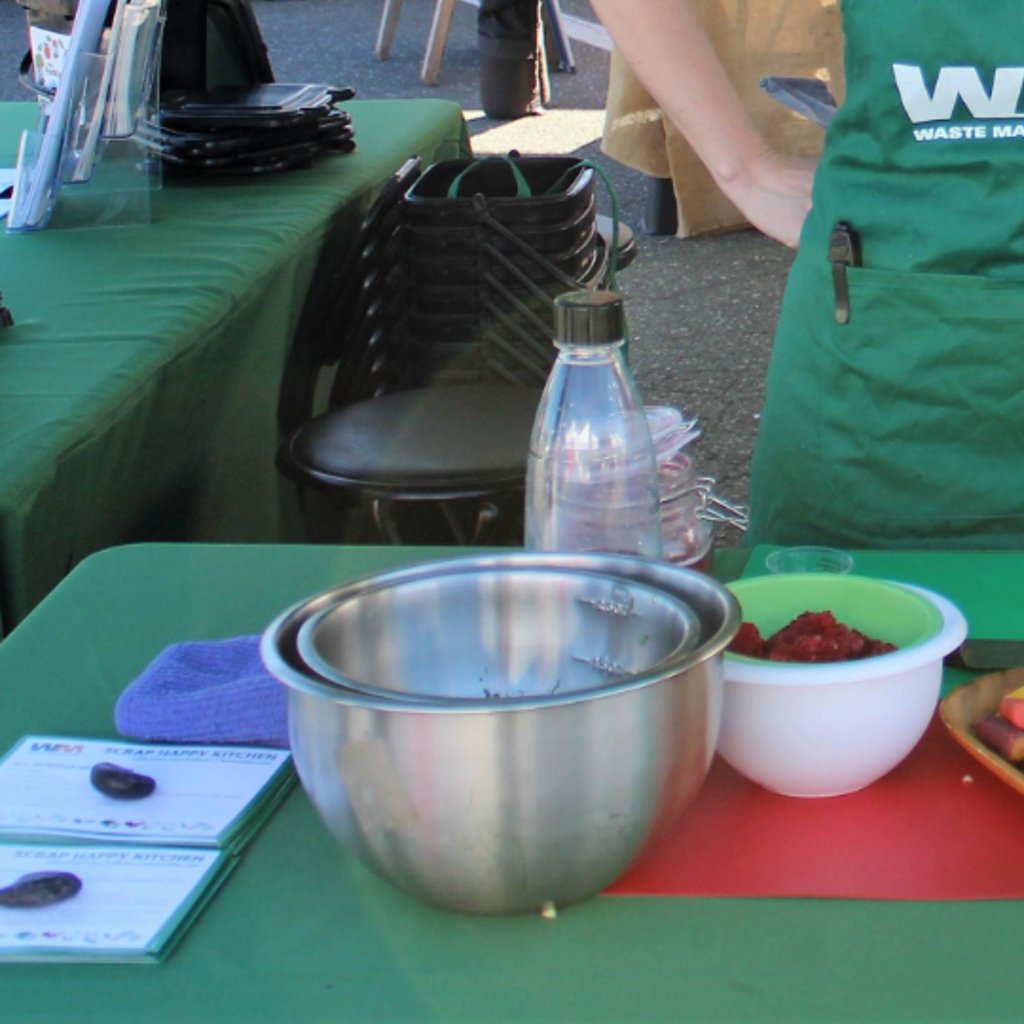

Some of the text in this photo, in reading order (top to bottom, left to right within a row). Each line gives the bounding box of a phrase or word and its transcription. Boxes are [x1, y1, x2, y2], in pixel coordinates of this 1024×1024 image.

[913, 127, 987, 141] WASTE
[104, 747, 156, 757] SCRAP
[157, 749, 206, 759] HAPPY
[211, 752, 278, 761] KITCHEN
[72, 852, 128, 860] HAPPY
[132, 853, 207, 863] KITCHEN
